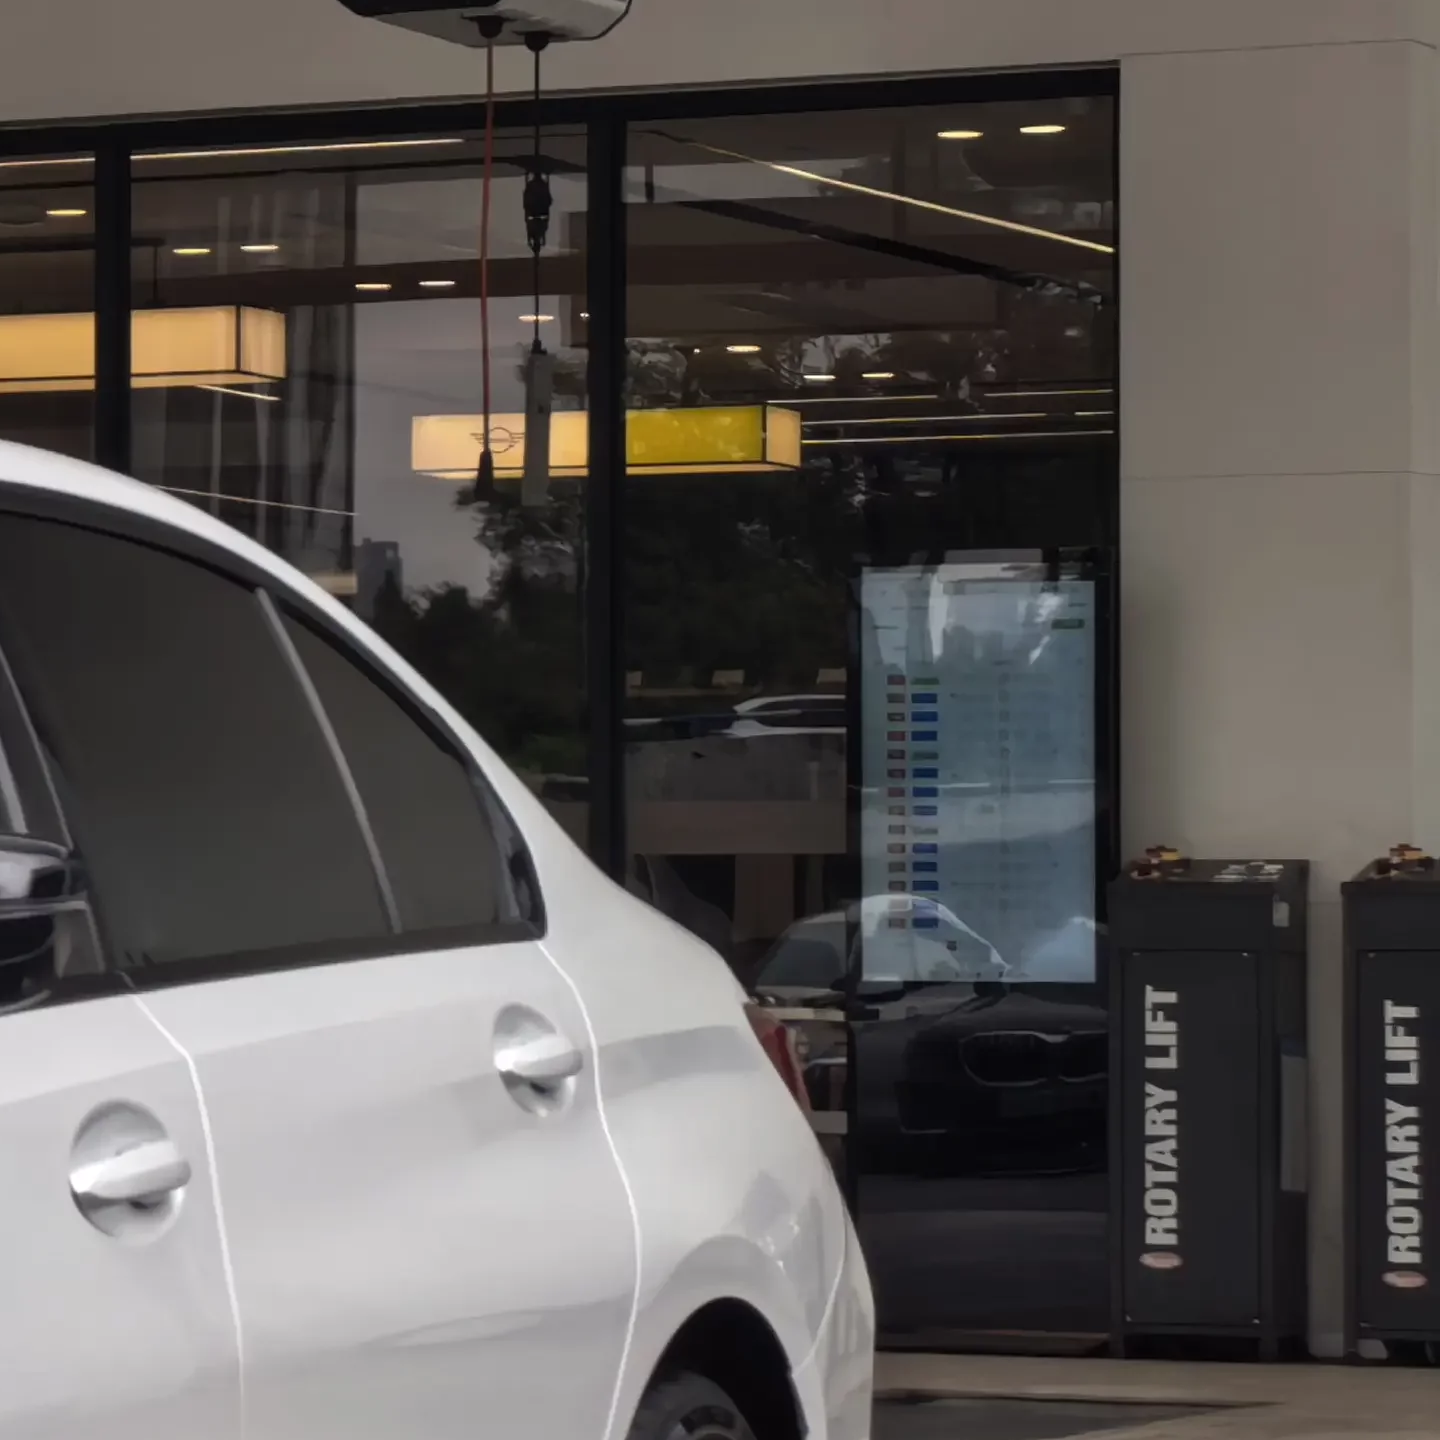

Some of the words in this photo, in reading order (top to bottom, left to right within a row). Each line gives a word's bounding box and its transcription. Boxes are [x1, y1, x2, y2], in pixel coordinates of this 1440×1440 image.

[1144, 984, 1179, 1069] LIFT
[1383, 999, 1420, 1085] LIFT
[1144, 1081, 1179, 1246] ROTARY
[1384, 1097, 1422, 1264] ROTARY
